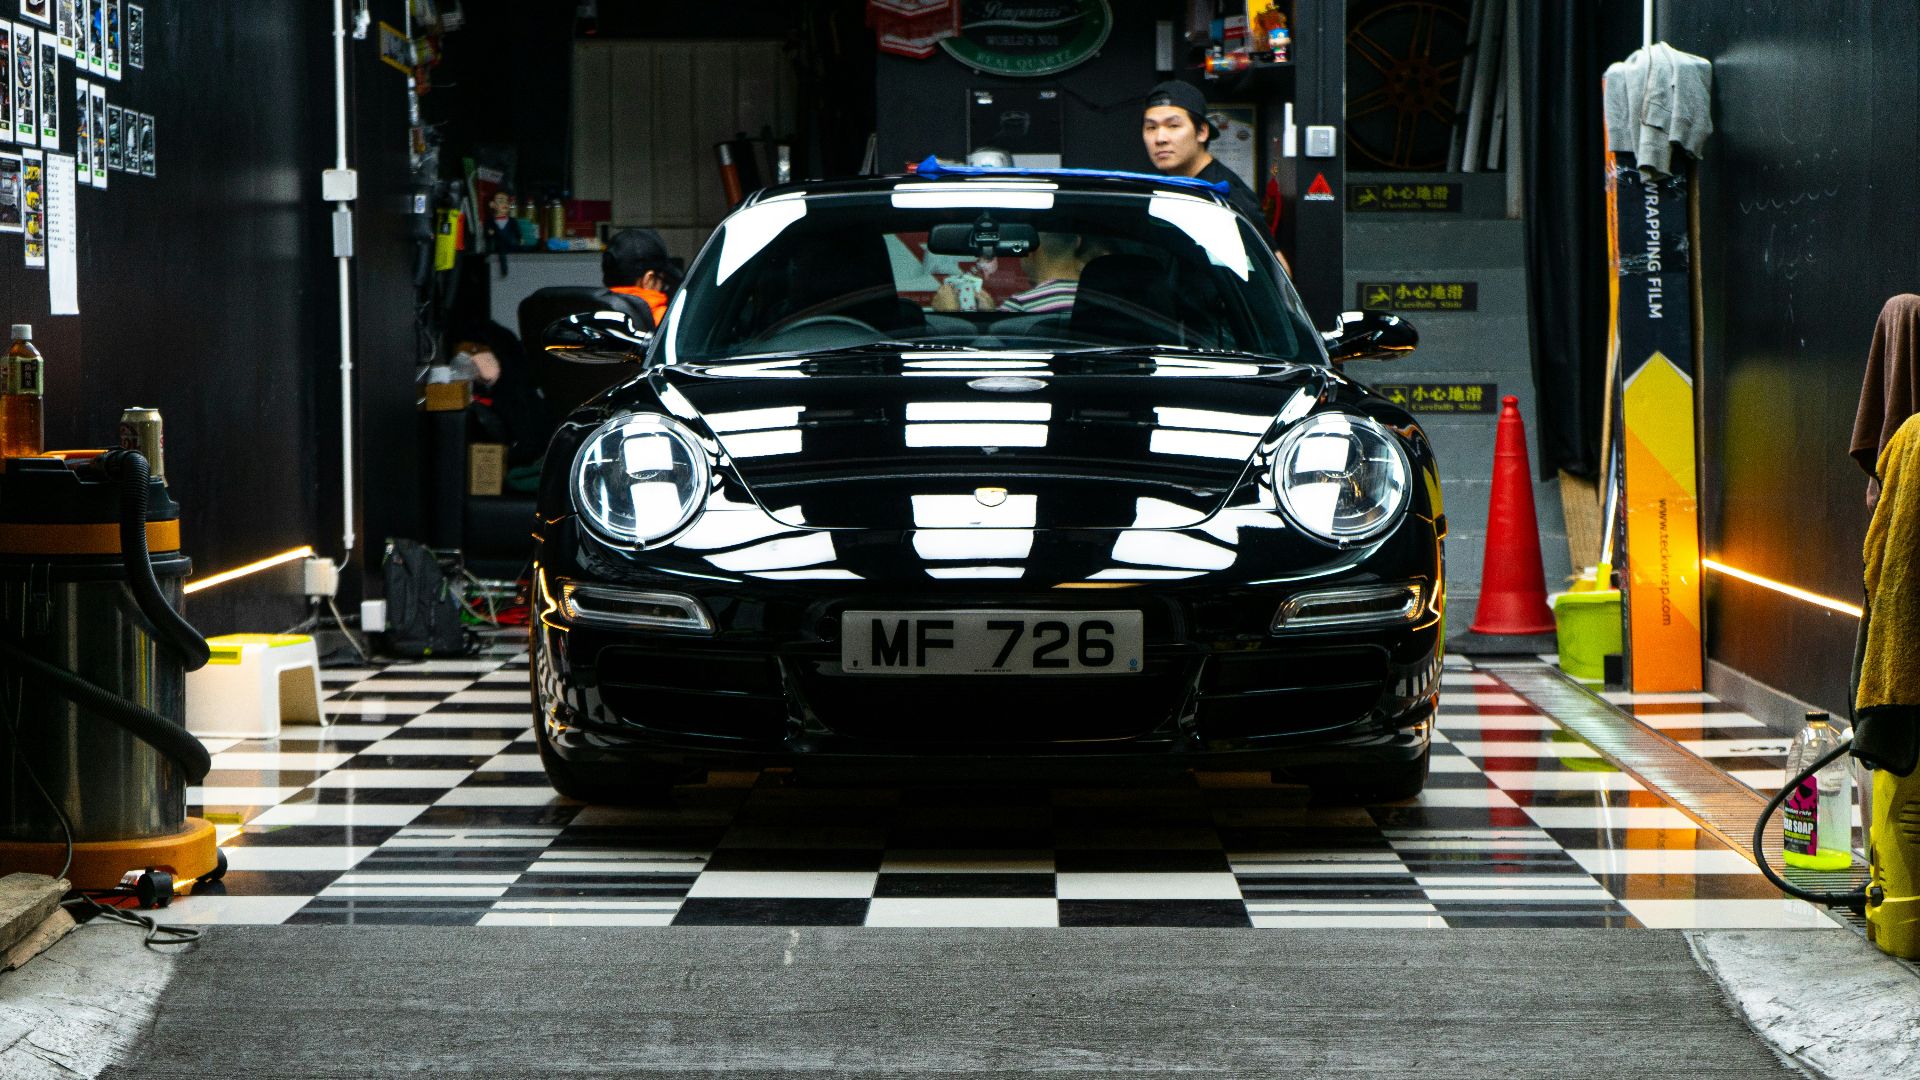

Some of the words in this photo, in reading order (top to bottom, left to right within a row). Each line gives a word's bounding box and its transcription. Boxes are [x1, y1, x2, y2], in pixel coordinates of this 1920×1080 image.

[1382, 184, 1448, 200] 小心地滑
[1644, 182, 1660, 272] WRAPPING
[1395, 283, 1464, 300] 小心地滑
[1648, 277, 1663, 319] FILM
[1412, 385, 1483, 402] 小心地滑
[1658, 498, 1672, 626] www.teckwrap.com
[871, 618, 954, 667] MF
[987, 620, 1115, 668] 726
[1793, 820, 1813, 835] SOAP
